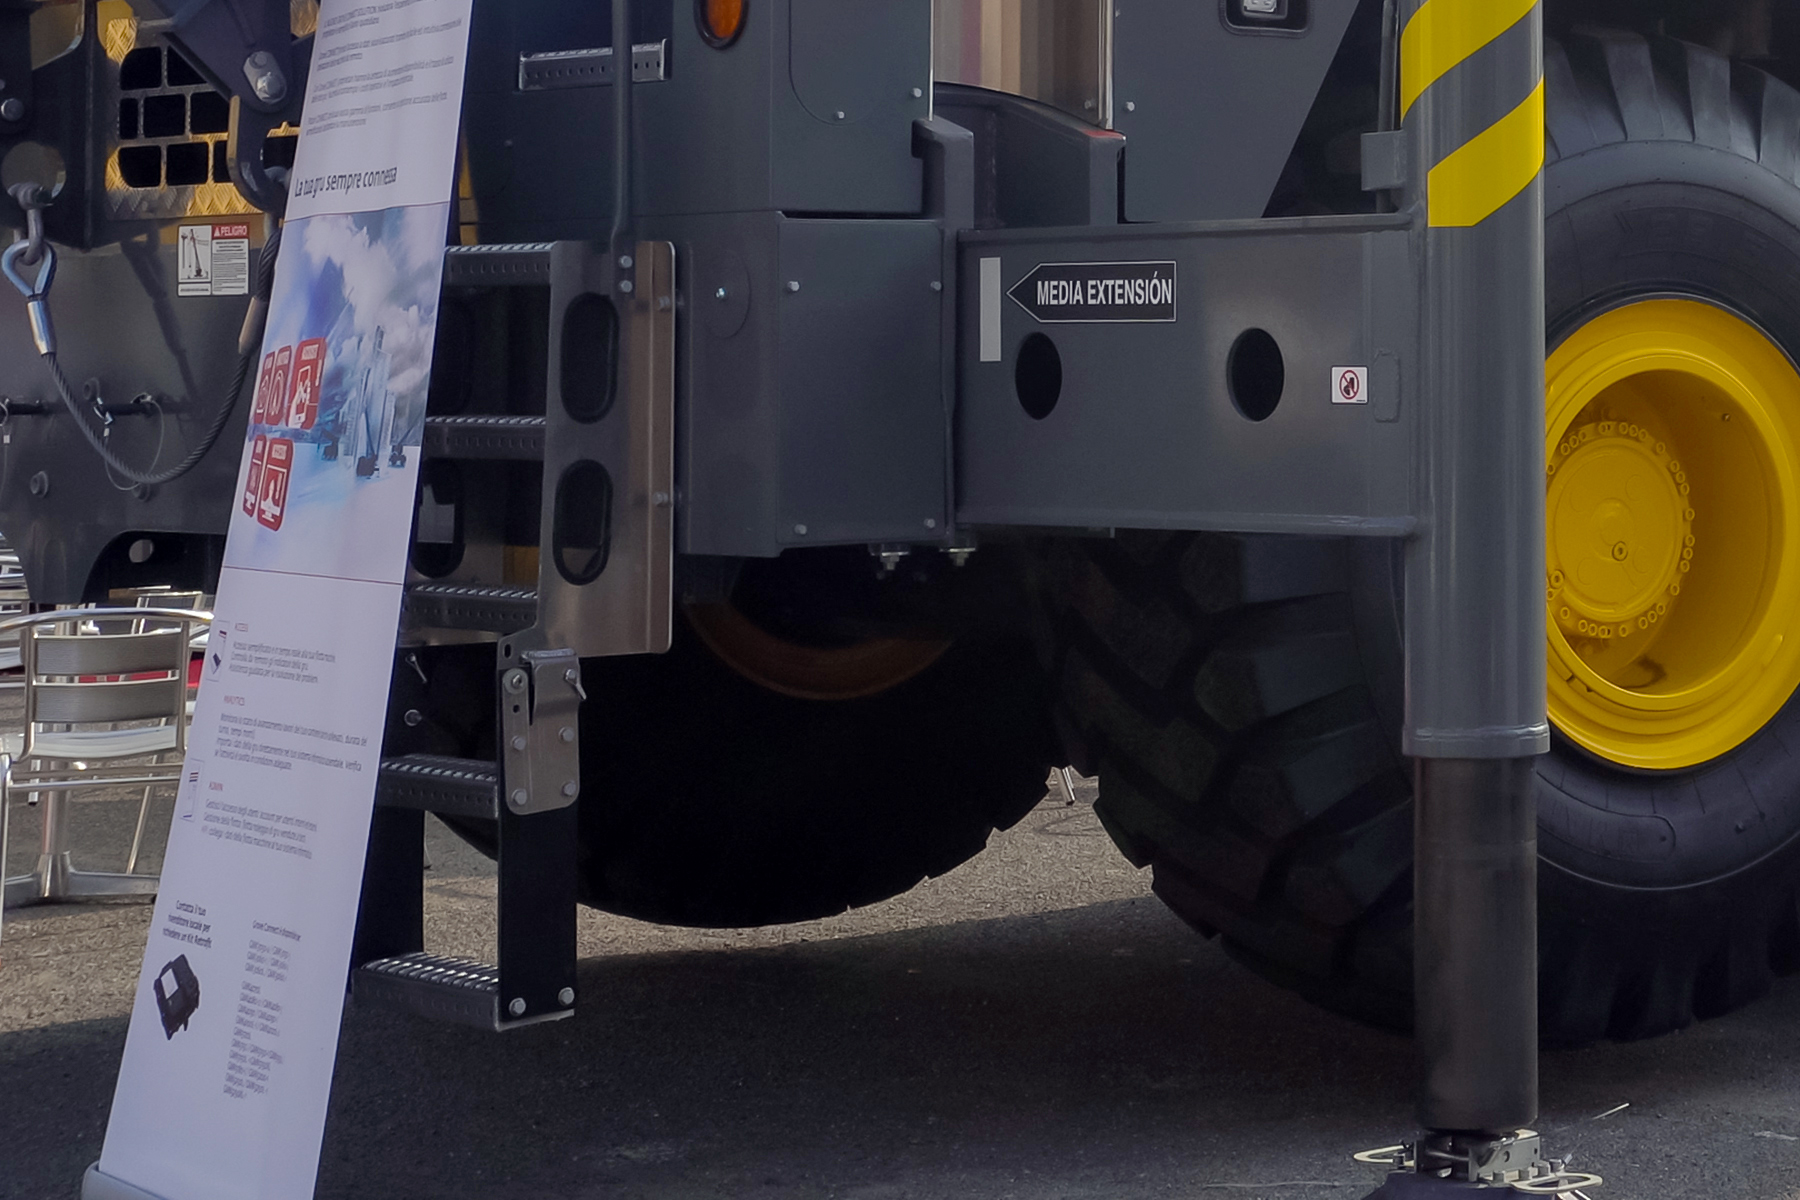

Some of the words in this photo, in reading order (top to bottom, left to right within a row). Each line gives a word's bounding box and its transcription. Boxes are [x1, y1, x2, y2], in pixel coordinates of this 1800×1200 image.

[326, 172, 361, 195] sempre
[220, 225, 248, 236] PELIGRO
[1036, 279, 1083, 306] MEDIA
[1087, 271, 1172, 306] EXTENSIÓN
